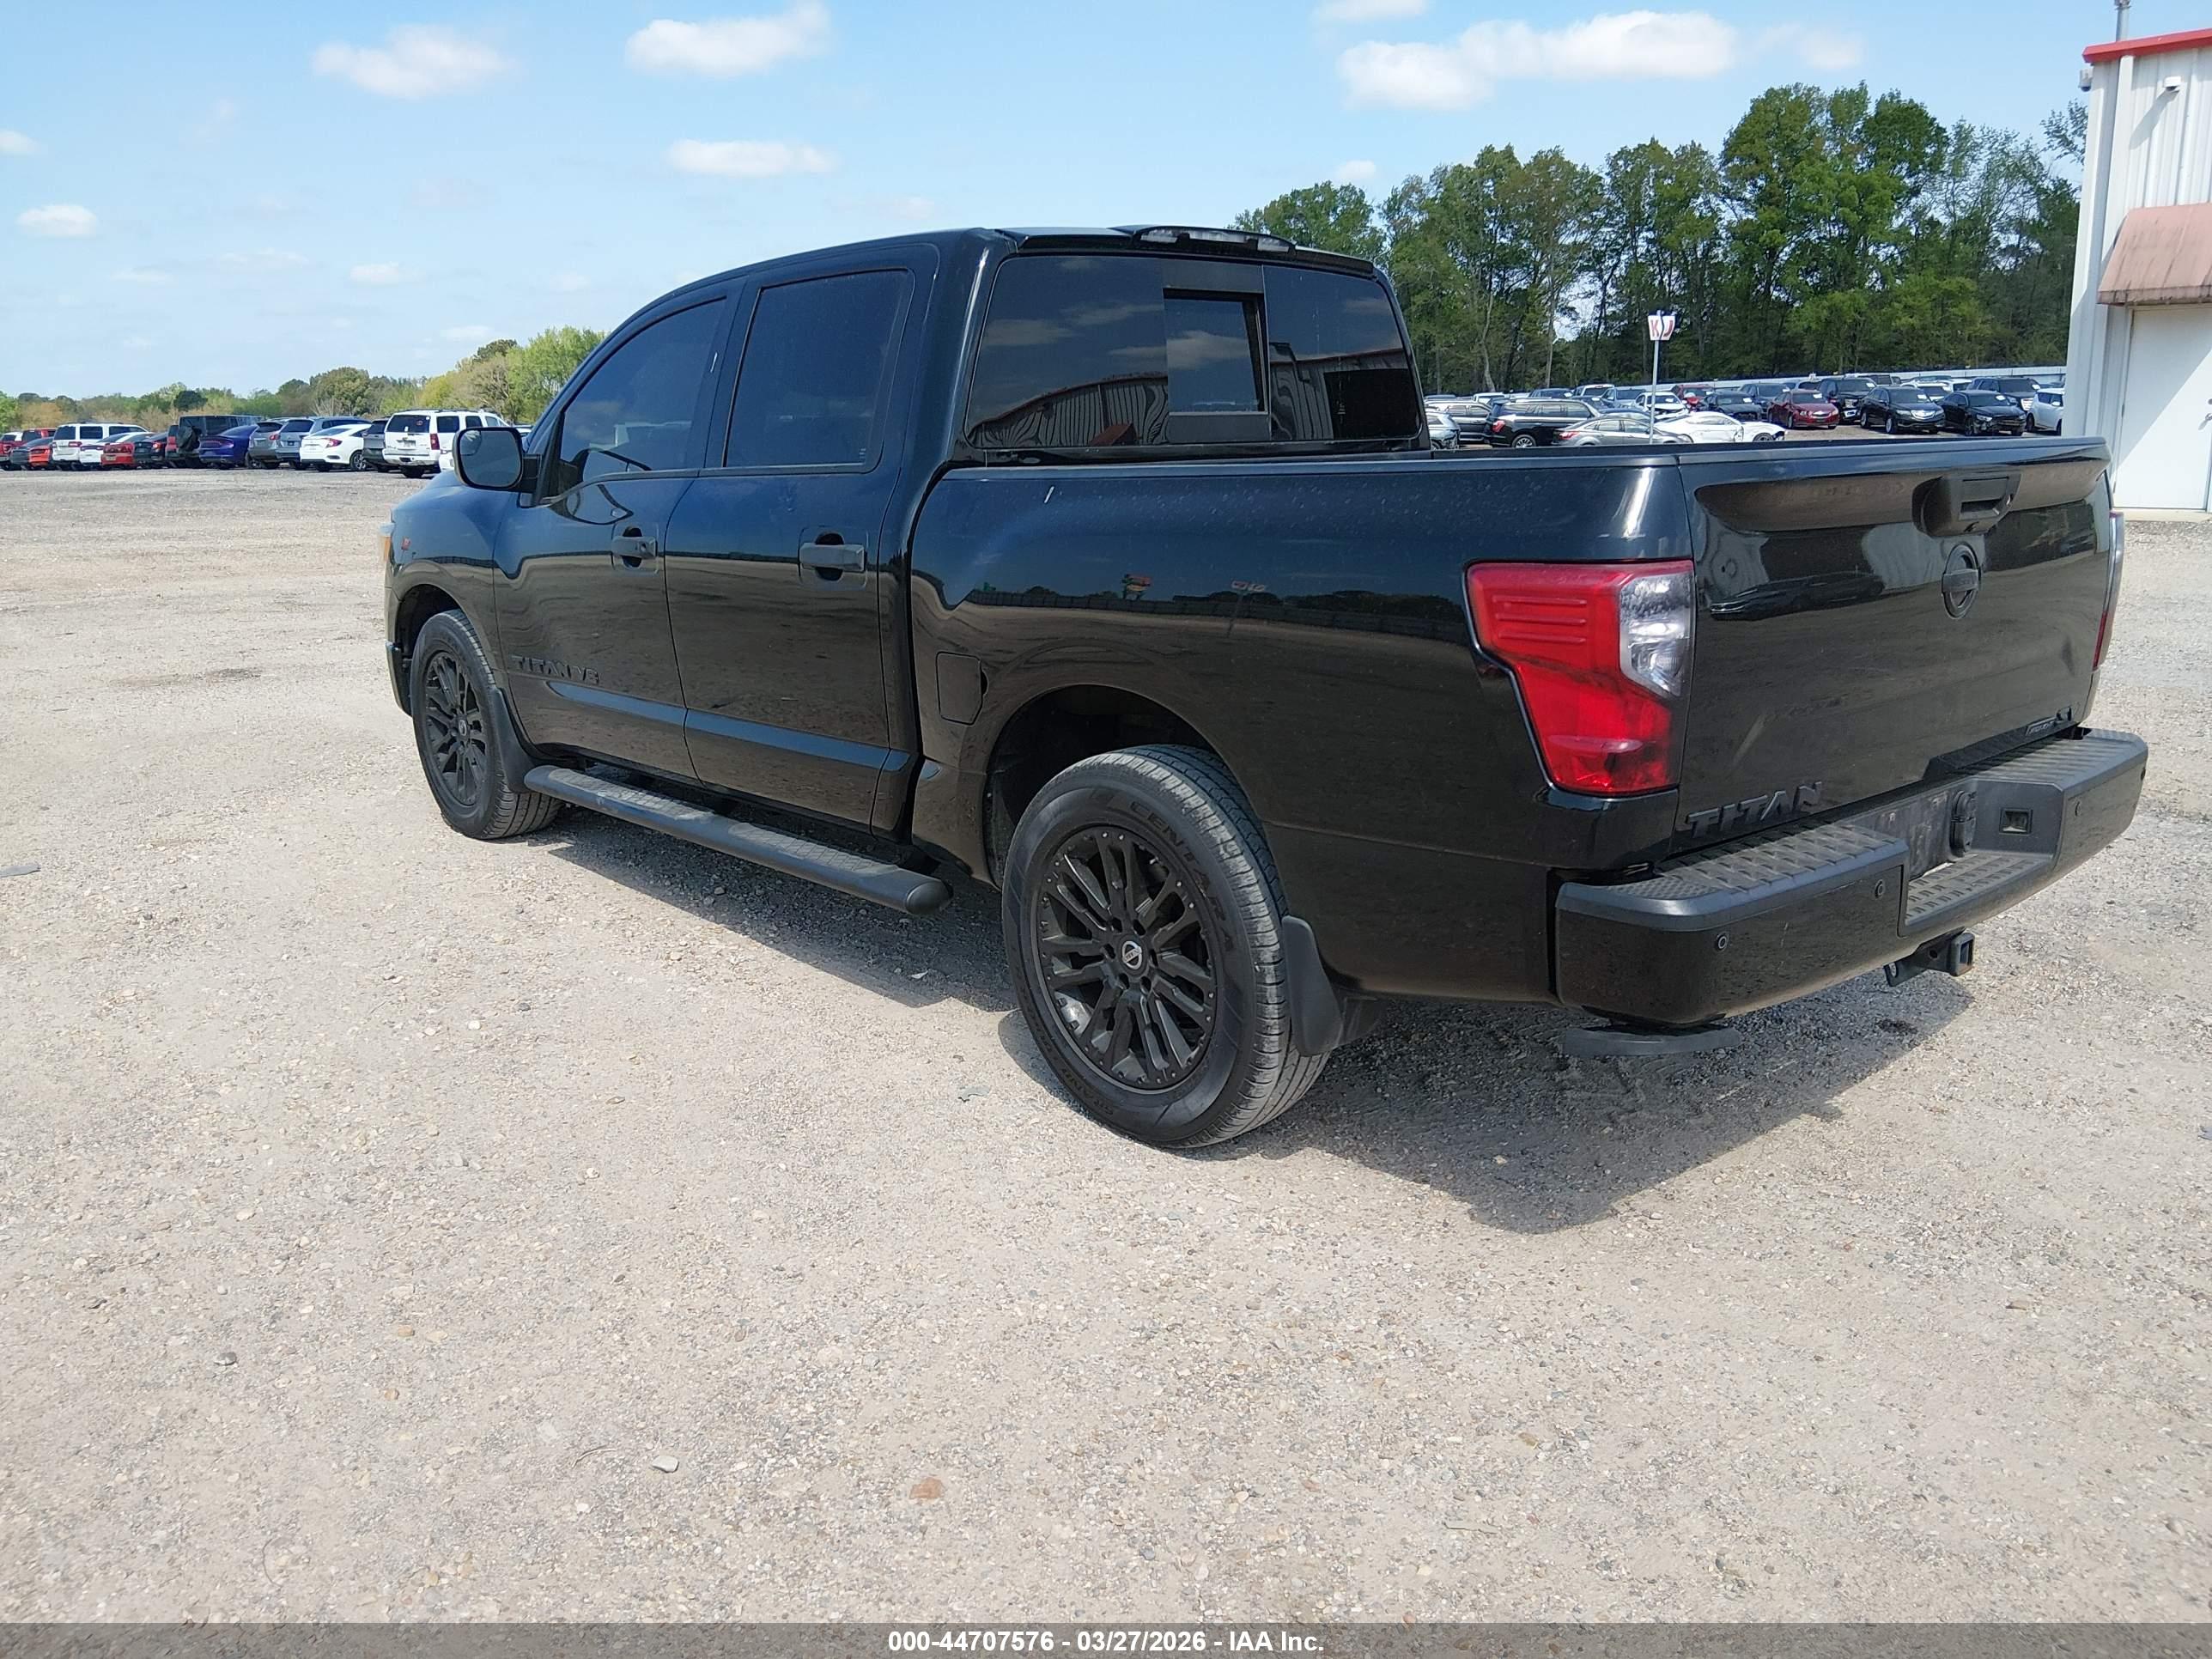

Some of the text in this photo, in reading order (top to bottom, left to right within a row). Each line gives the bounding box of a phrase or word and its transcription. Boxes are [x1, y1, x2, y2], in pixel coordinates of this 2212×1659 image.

[1650, 319, 1674, 337] K J
[511, 655, 571, 679] TITAN
[1686, 781, 1822, 838] TITAN
[1129, 799, 1234, 952] CENTARA
